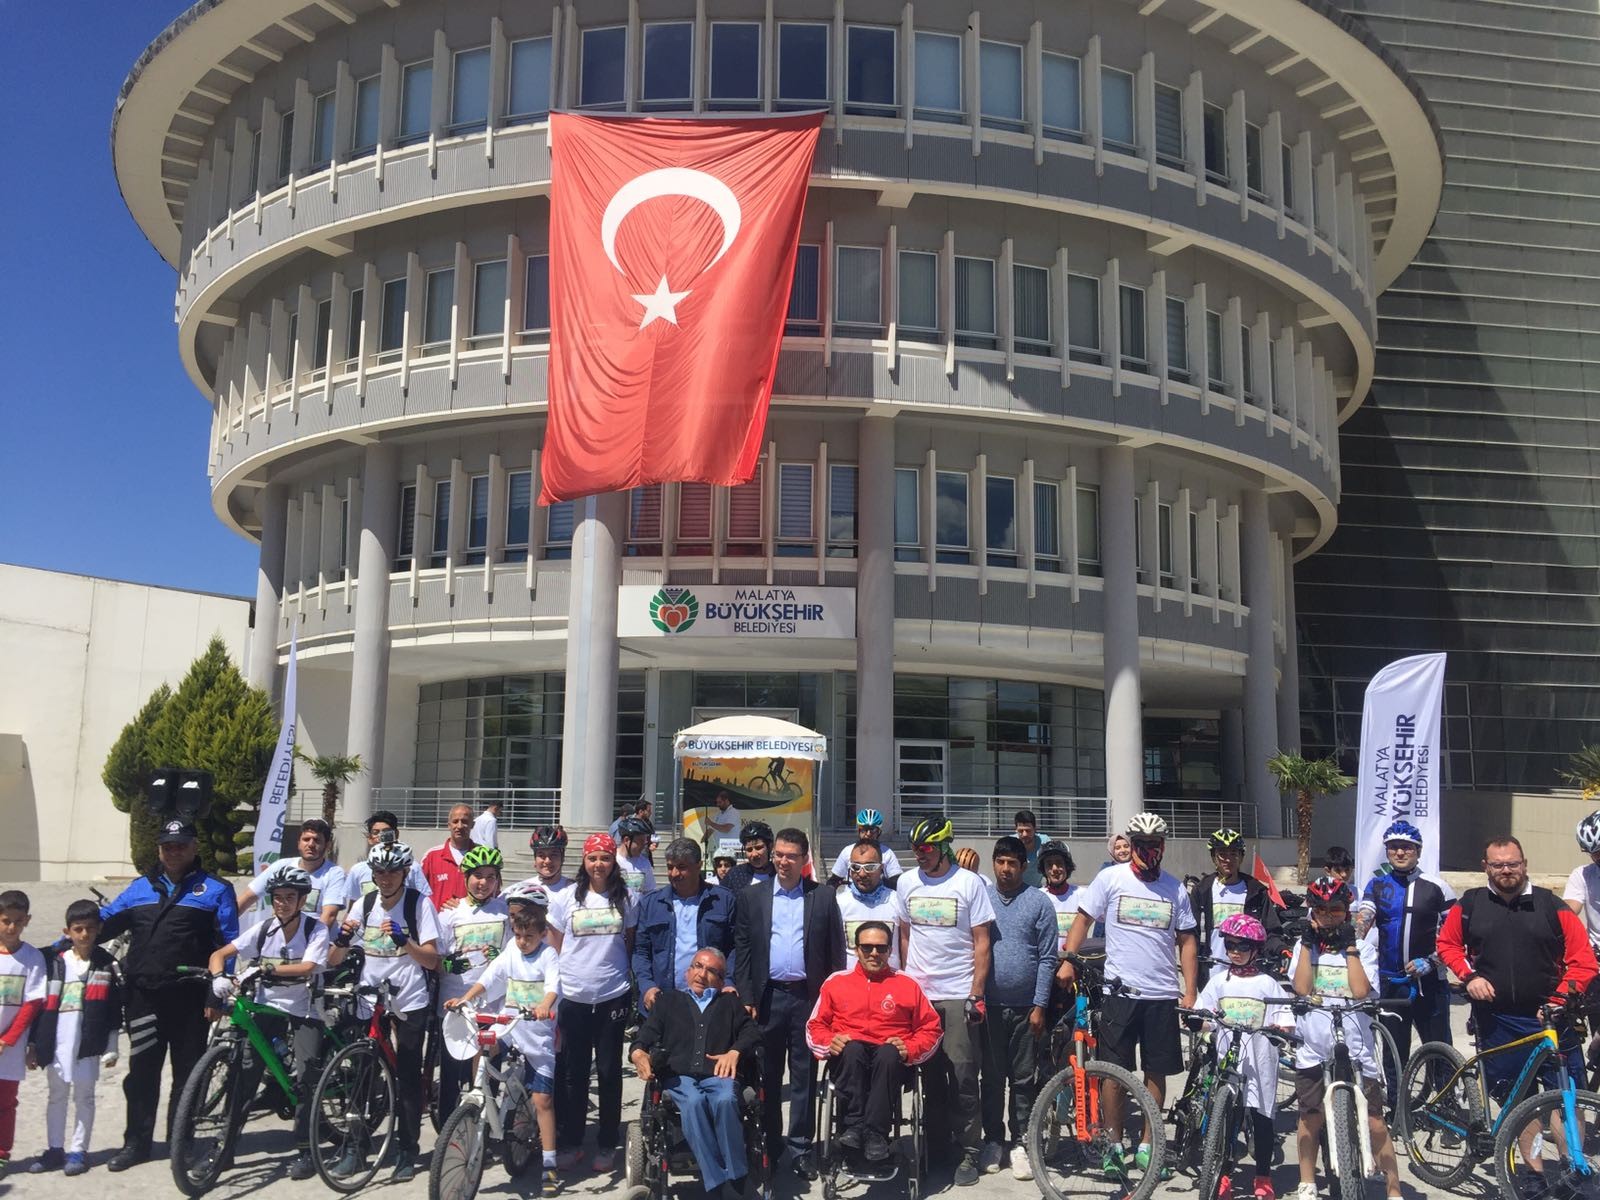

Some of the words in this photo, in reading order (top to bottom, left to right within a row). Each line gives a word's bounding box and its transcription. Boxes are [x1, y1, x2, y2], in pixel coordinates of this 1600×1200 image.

[734, 589, 796, 601] MALATYA
[1374, 745, 1391, 817] MALATYA
[1391, 713, 1417, 823] YÜKŞEHİR
